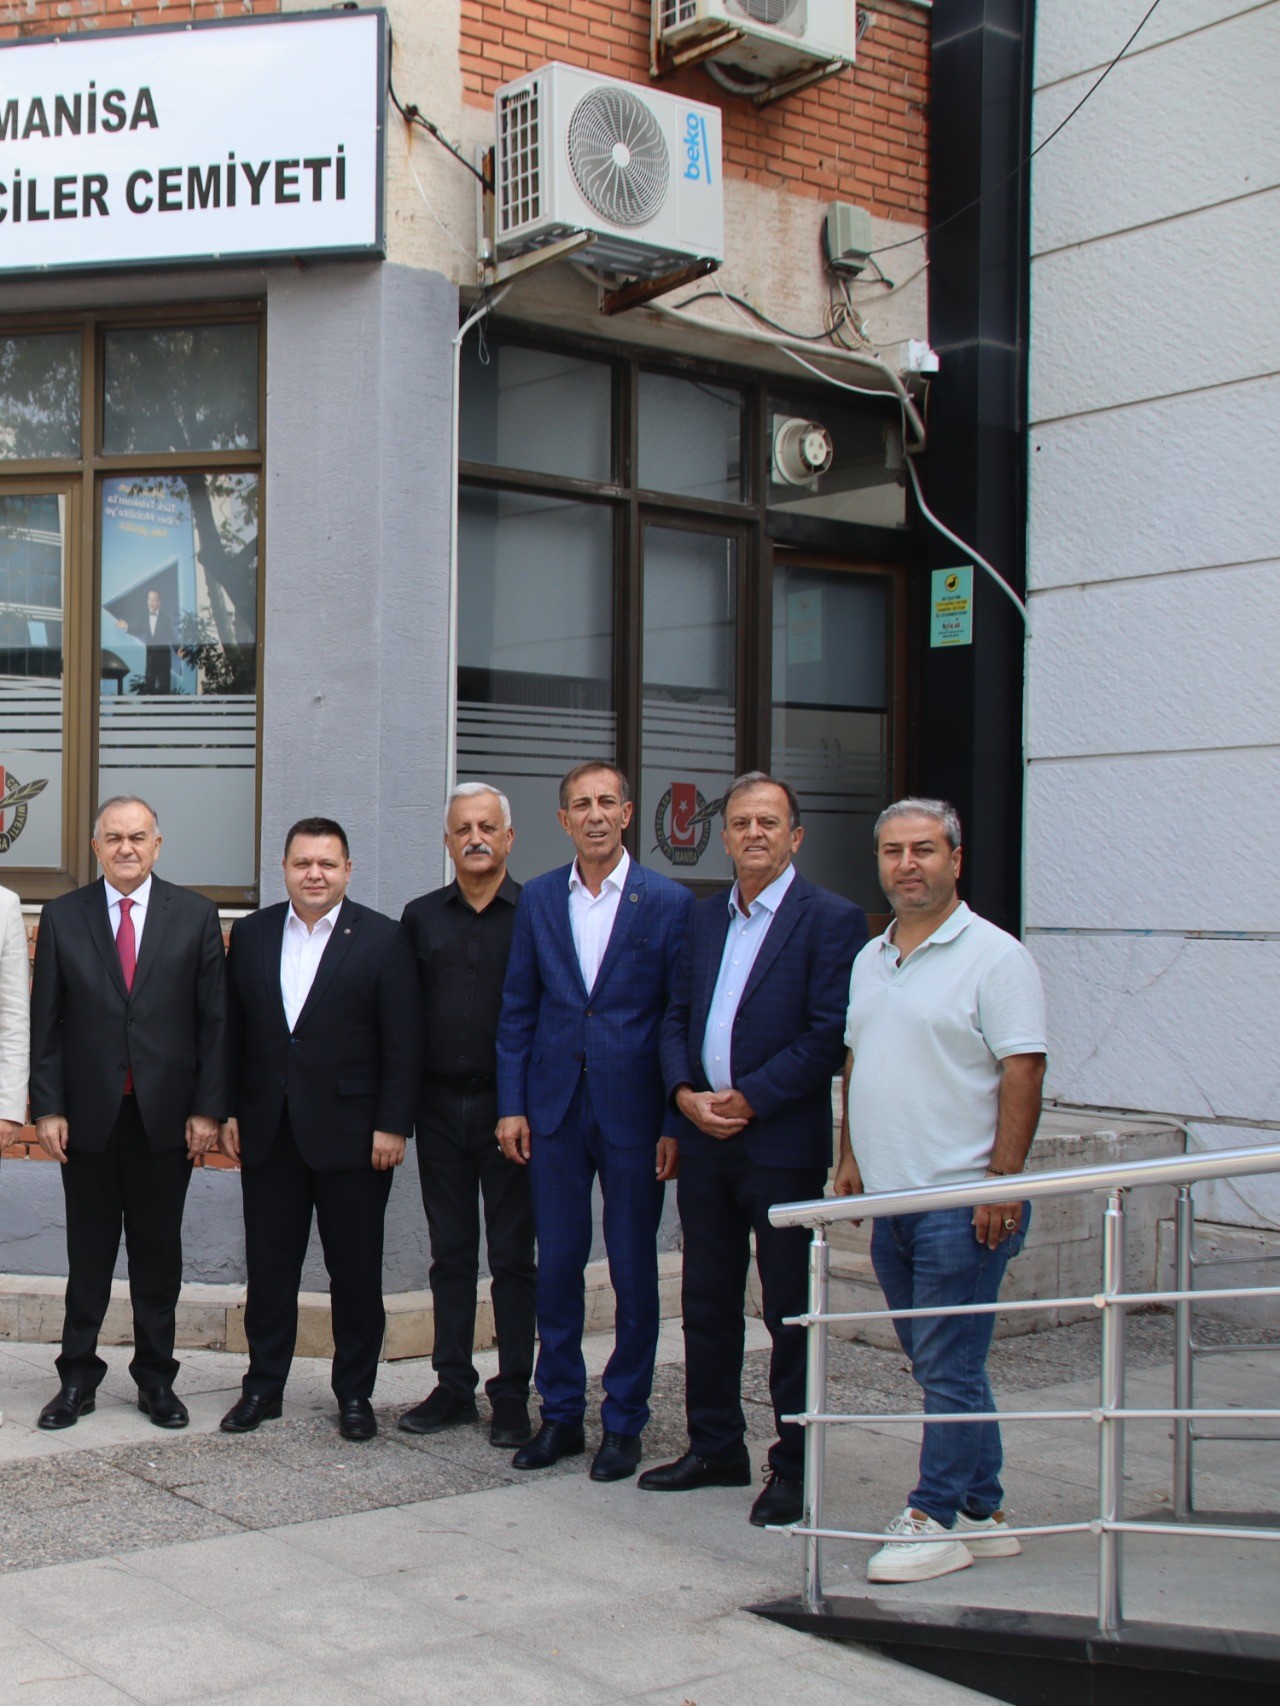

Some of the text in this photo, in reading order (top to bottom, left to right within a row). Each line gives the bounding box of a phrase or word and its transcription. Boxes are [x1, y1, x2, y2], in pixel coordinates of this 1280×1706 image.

[126, 144, 347, 214] CEMİYETİ
[683, 112, 700, 180] beko
[675, 849, 698, 862] MANİSA
